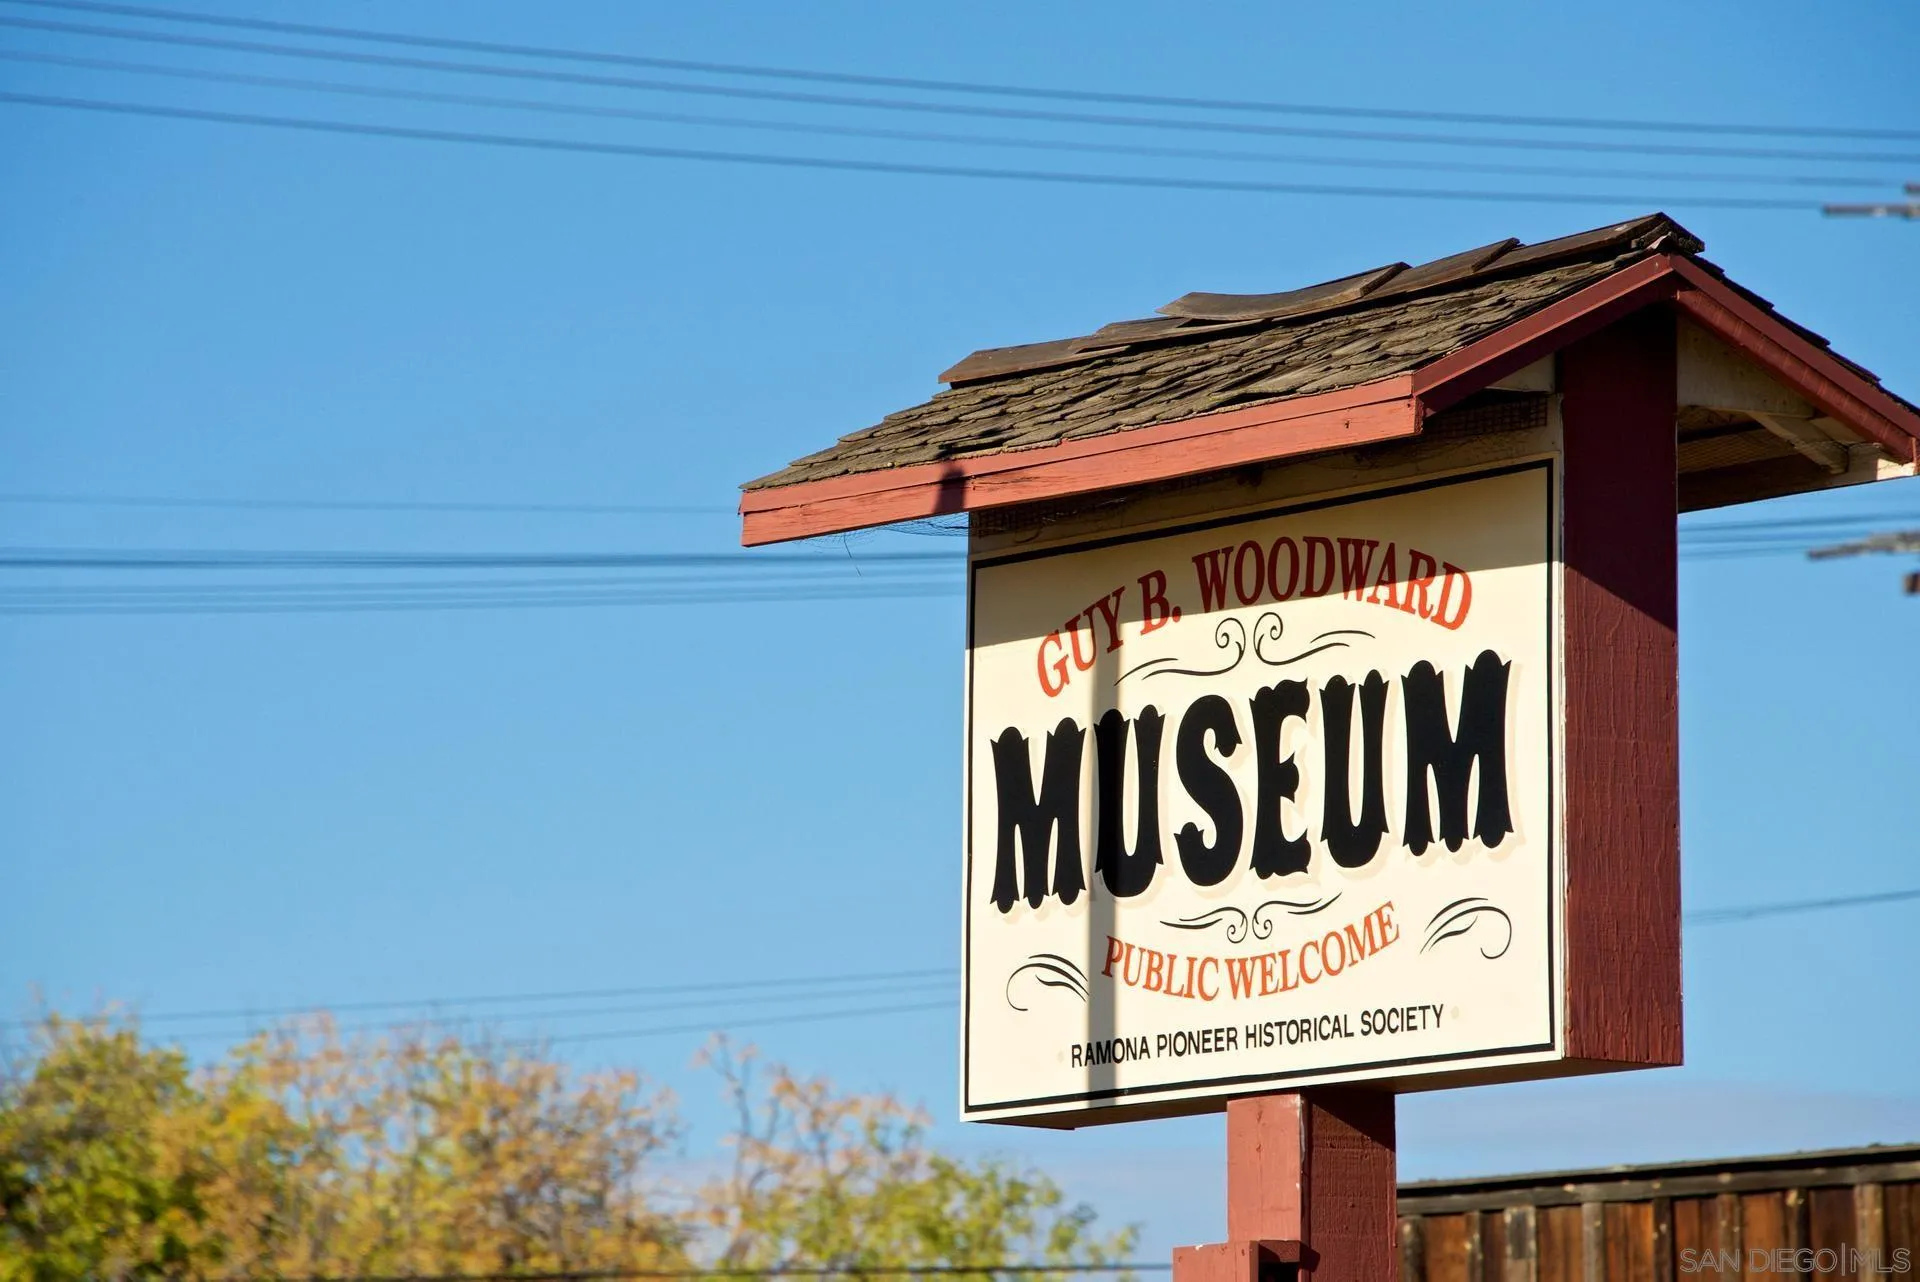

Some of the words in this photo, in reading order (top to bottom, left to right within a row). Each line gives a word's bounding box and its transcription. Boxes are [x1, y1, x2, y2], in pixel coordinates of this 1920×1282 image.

[1036, 586, 1127, 698] GUY
[1137, 569, 1181, 635] B.
[1192, 535, 1474, 631] WOODWARD
[990, 649, 1514, 914] MUSEUM
[1101, 934, 1220, 1002] PUBLIC
[1225, 900, 1401, 1000] WELCOME
[1071, 1033, 1151, 1068] RAMONA
[1156, 1025, 1238, 1058] PIONEER
[1245, 1013, 1354, 1049] HISTORICAL
[1360, 1003, 1444, 1034] SOCIETY
